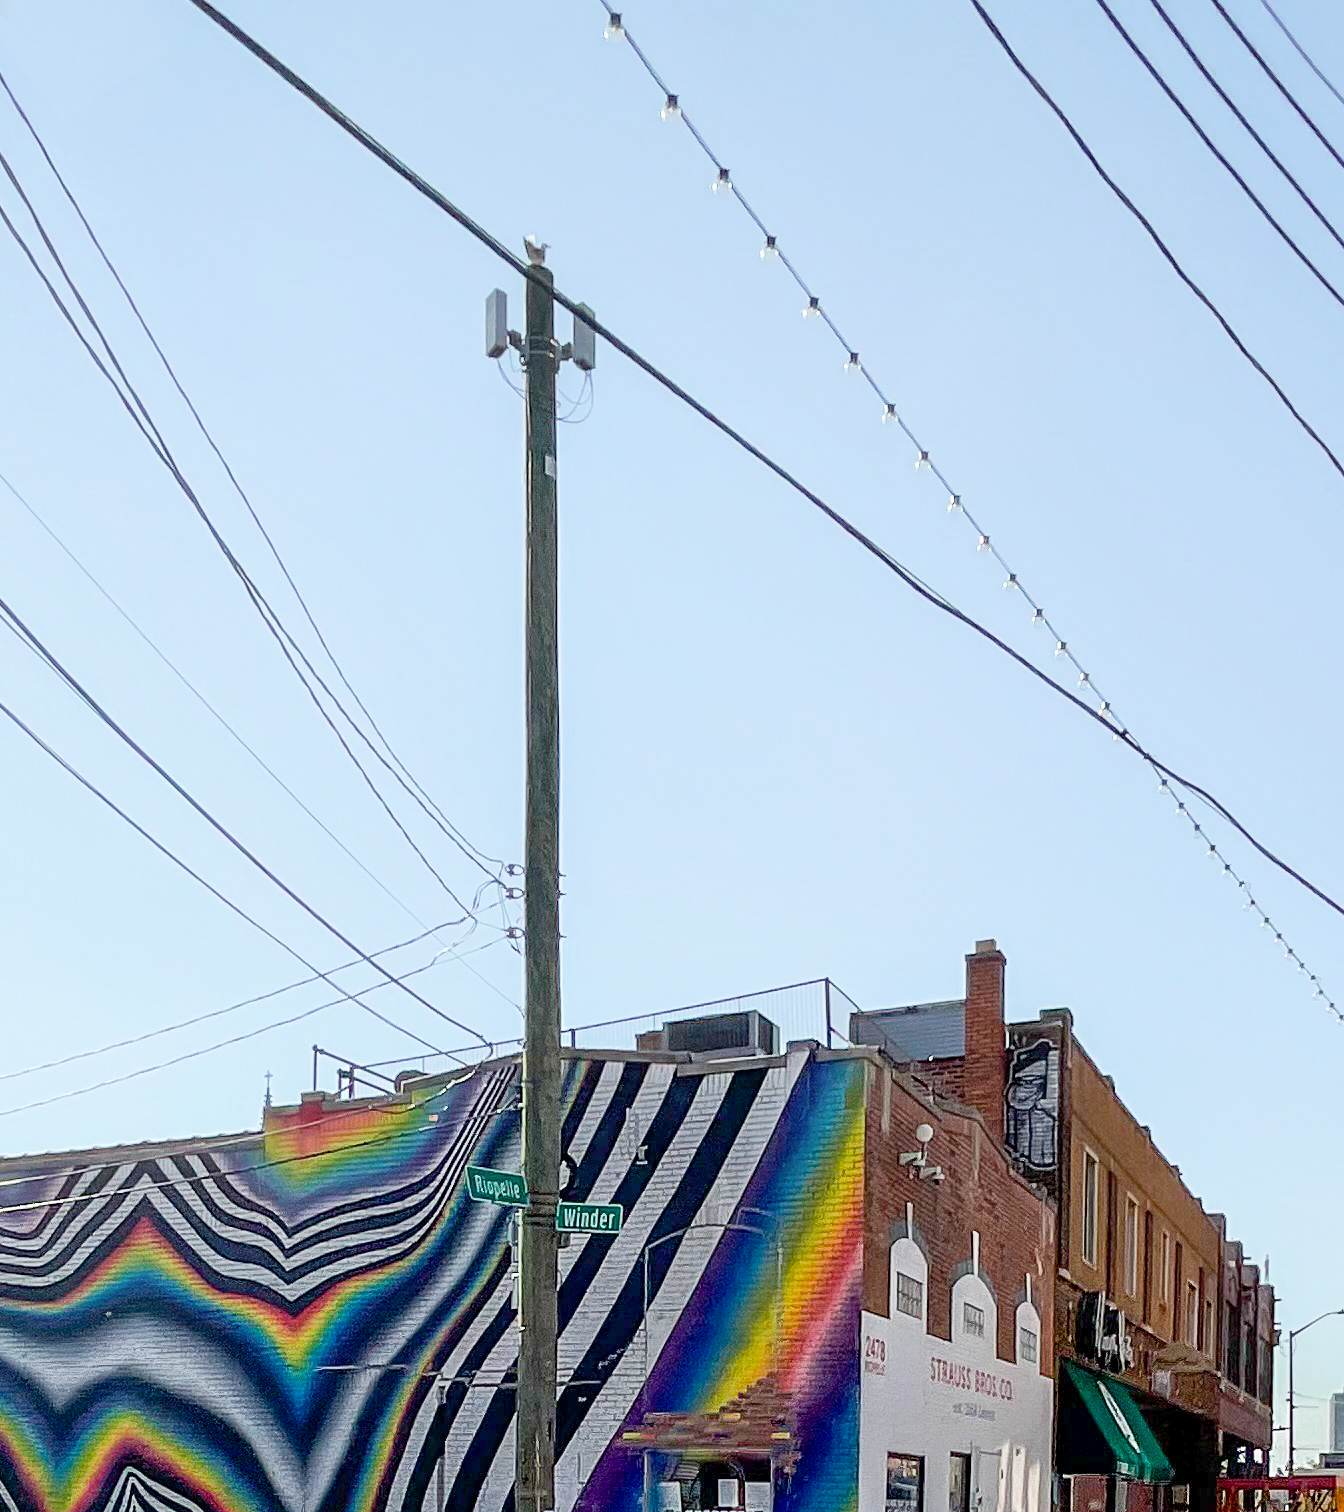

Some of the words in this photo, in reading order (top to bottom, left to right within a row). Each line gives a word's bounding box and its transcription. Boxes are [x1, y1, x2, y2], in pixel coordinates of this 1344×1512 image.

[474, 1174, 521, 1199] Riopelle
[564, 1206, 616, 1229] Winder
[865, 1335, 886, 1362] 2478
[930, 1356, 972, 1390] STRAUSS
